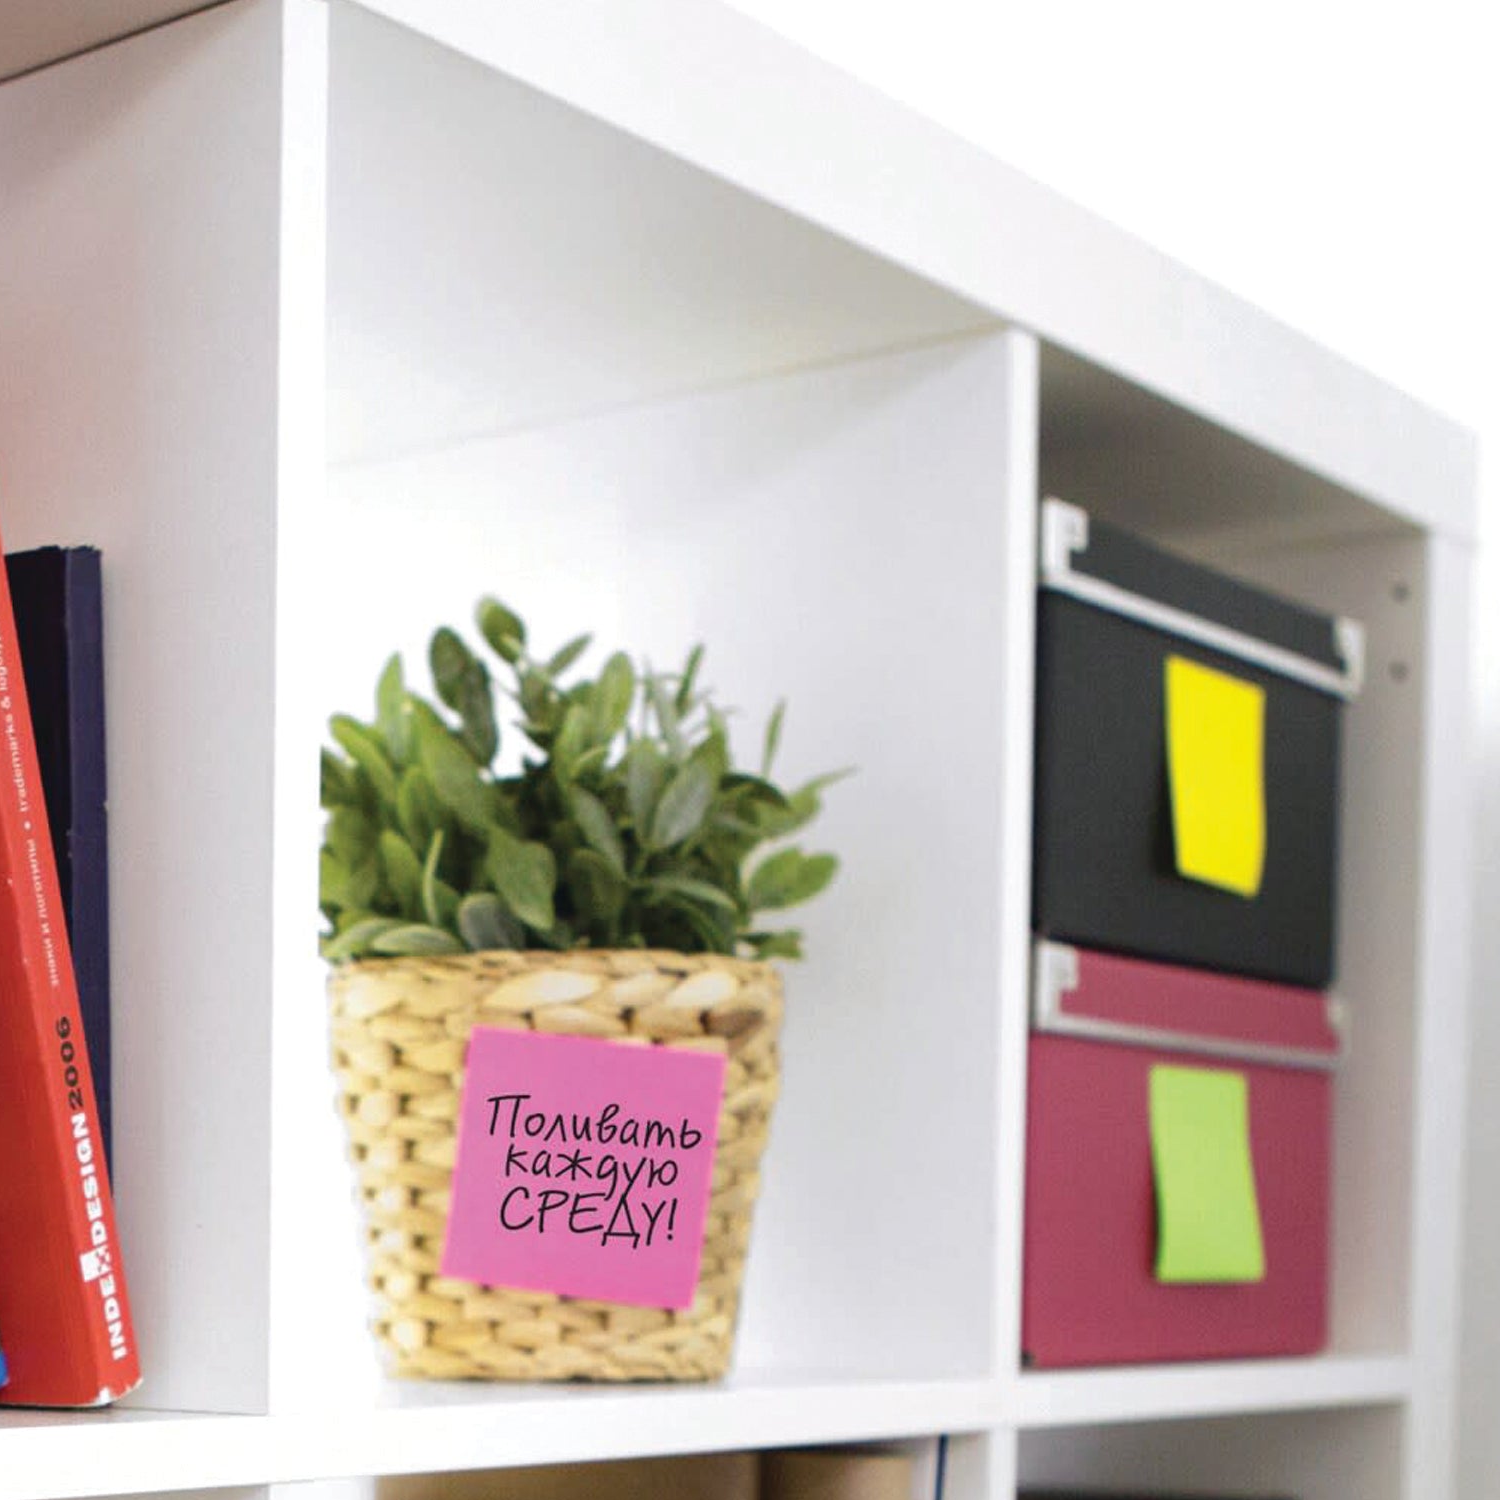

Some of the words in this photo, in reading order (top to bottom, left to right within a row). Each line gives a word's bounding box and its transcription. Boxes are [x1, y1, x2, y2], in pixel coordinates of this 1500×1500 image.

[1, 714, 30, 813] trademarks
[56, 1014, 84, 1111] 2006
[487, 1094, 702, 1150] Поливать
[505, 1144, 679, 1200] каждую
[500, 1186, 678, 1249] СРЕДУ!
